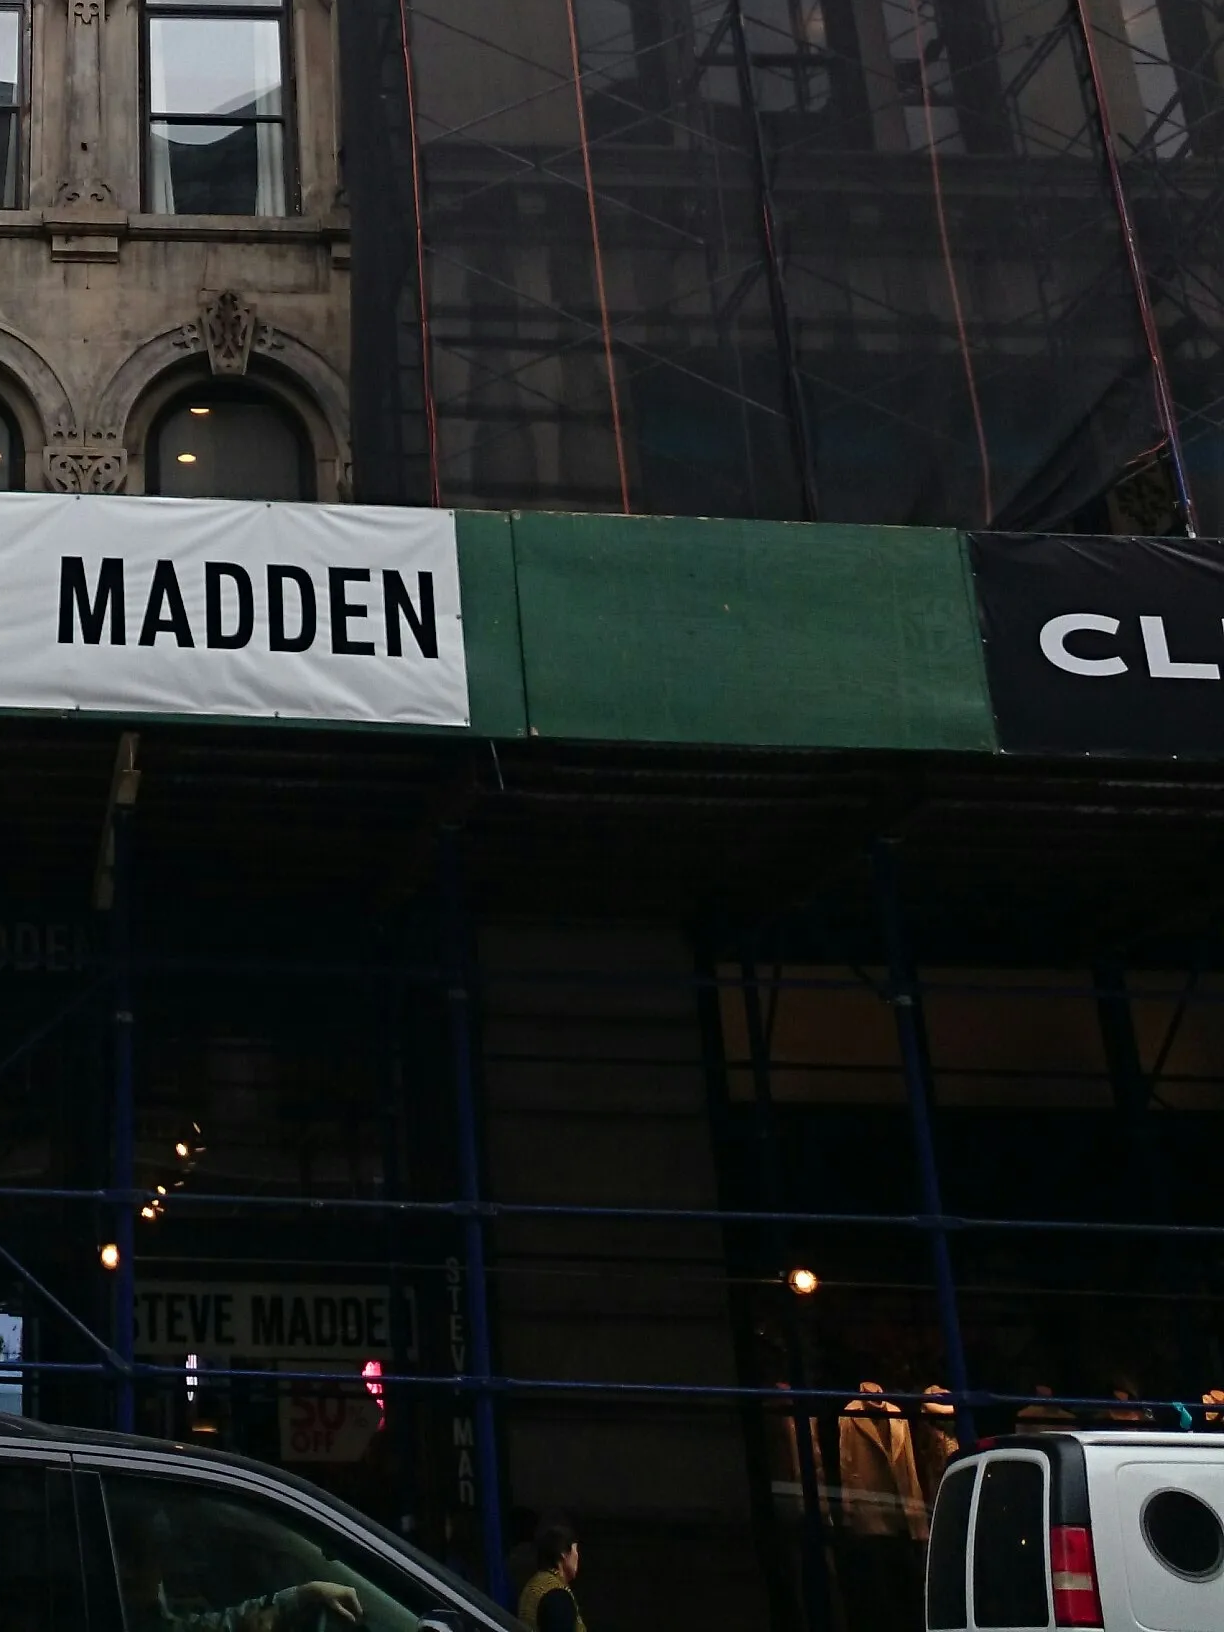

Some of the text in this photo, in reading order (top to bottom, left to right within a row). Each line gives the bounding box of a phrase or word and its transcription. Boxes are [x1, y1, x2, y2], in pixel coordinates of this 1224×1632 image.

[57, 555, 440, 659] MADDEN
[1039, 613, 1224, 679] CL
[133, 1292, 413, 1348] TEVE MADDE
[444, 1256, 467, 1396] STEV
[291, 1430, 335, 1454] OFF
